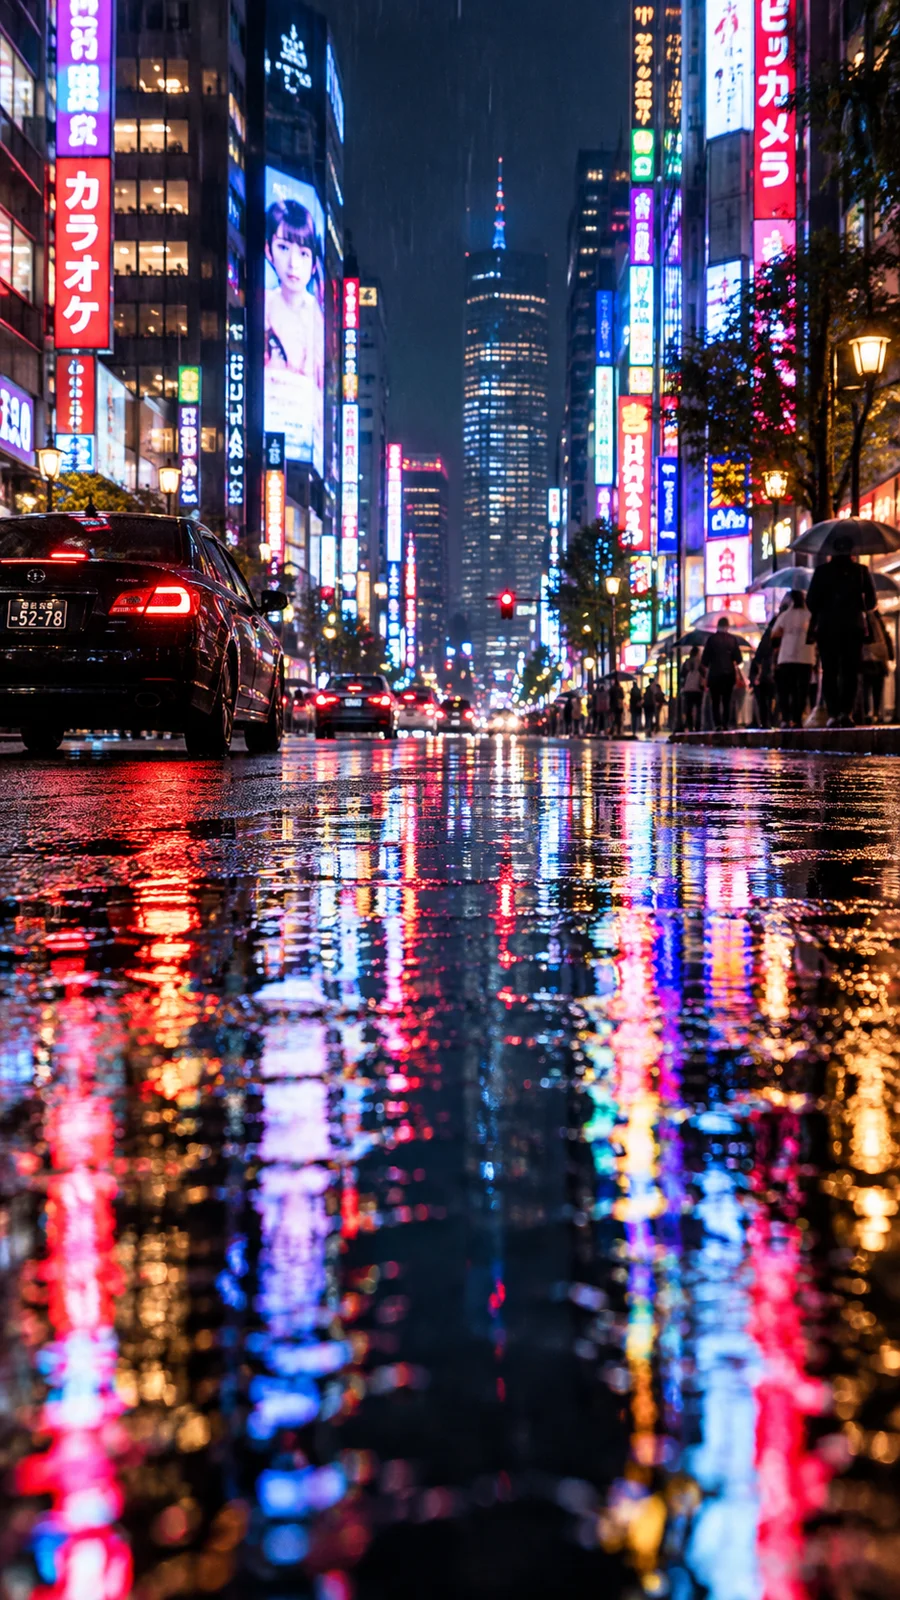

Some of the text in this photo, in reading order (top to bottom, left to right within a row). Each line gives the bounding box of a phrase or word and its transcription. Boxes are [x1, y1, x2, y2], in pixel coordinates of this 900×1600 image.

[63, 171, 99, 334] カラオケ
[19, 610, 63, 627] 52-78
